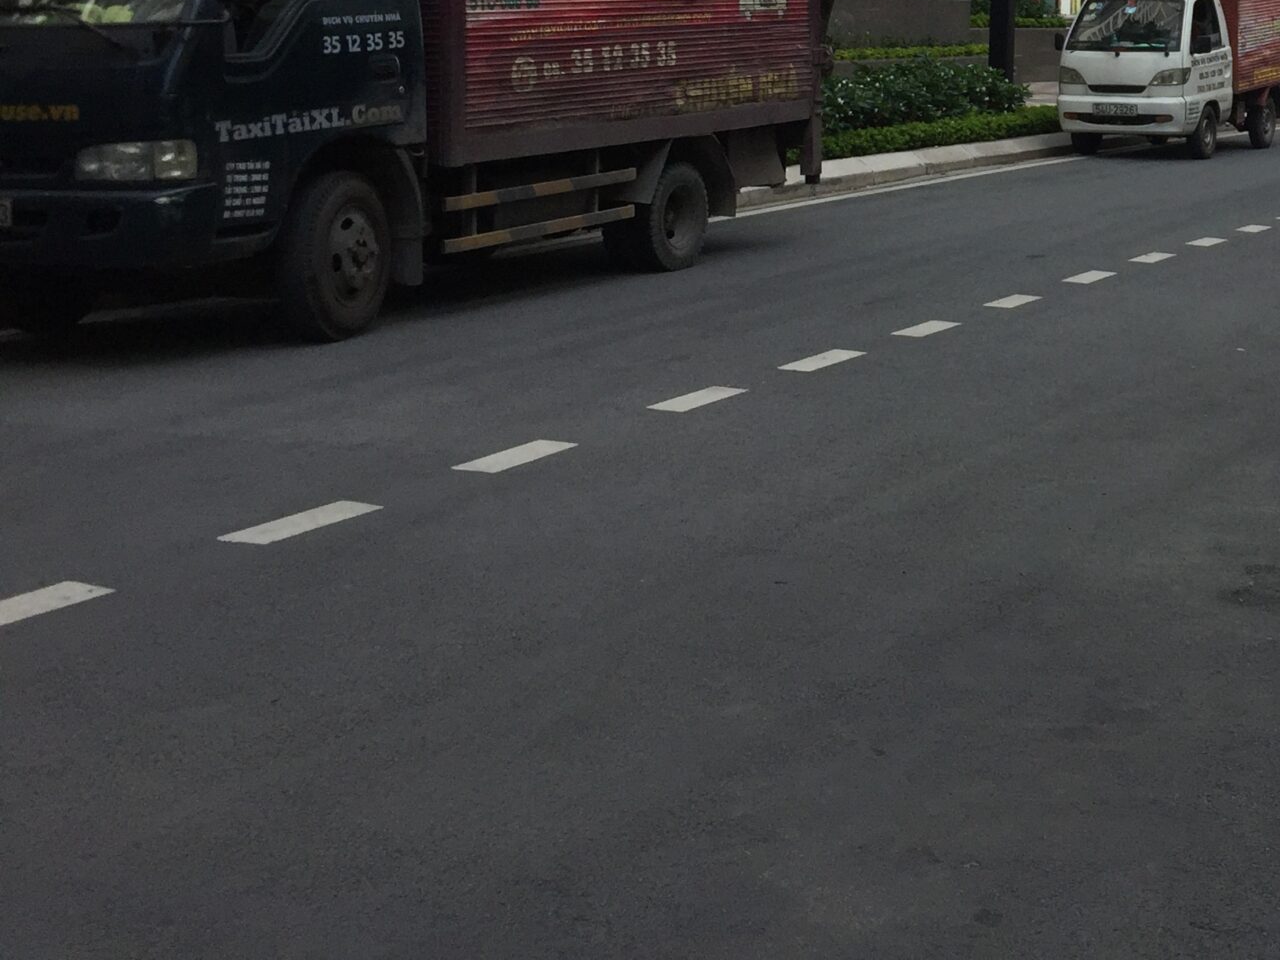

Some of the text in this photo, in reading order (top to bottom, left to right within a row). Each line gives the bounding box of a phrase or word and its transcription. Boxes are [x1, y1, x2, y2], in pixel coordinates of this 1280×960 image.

[322, 30, 405, 54] 35 12 35 35
